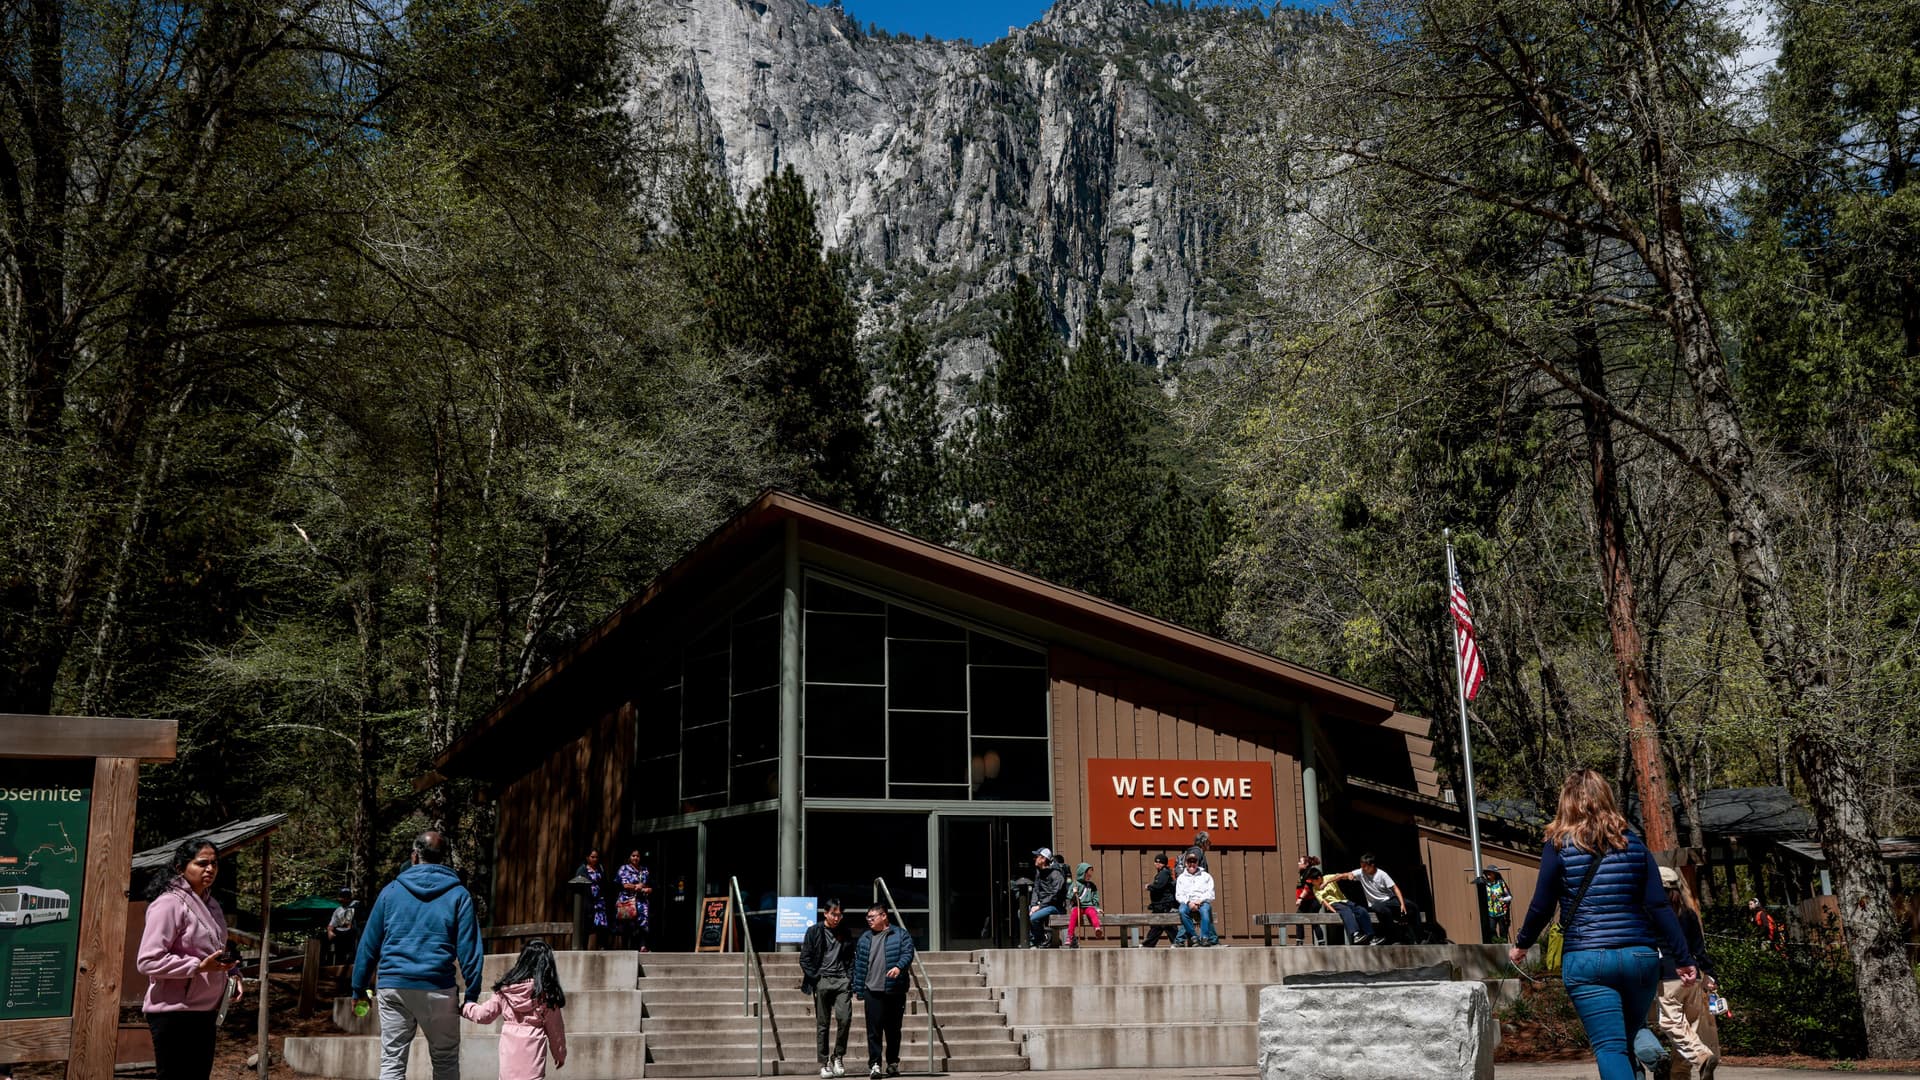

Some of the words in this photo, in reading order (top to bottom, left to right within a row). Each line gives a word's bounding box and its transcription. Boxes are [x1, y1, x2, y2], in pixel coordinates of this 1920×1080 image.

[0, 784, 82, 802] osemite
[1112, 776, 1253, 798] WELCOME
[1129, 807, 1239, 829] CENTER
